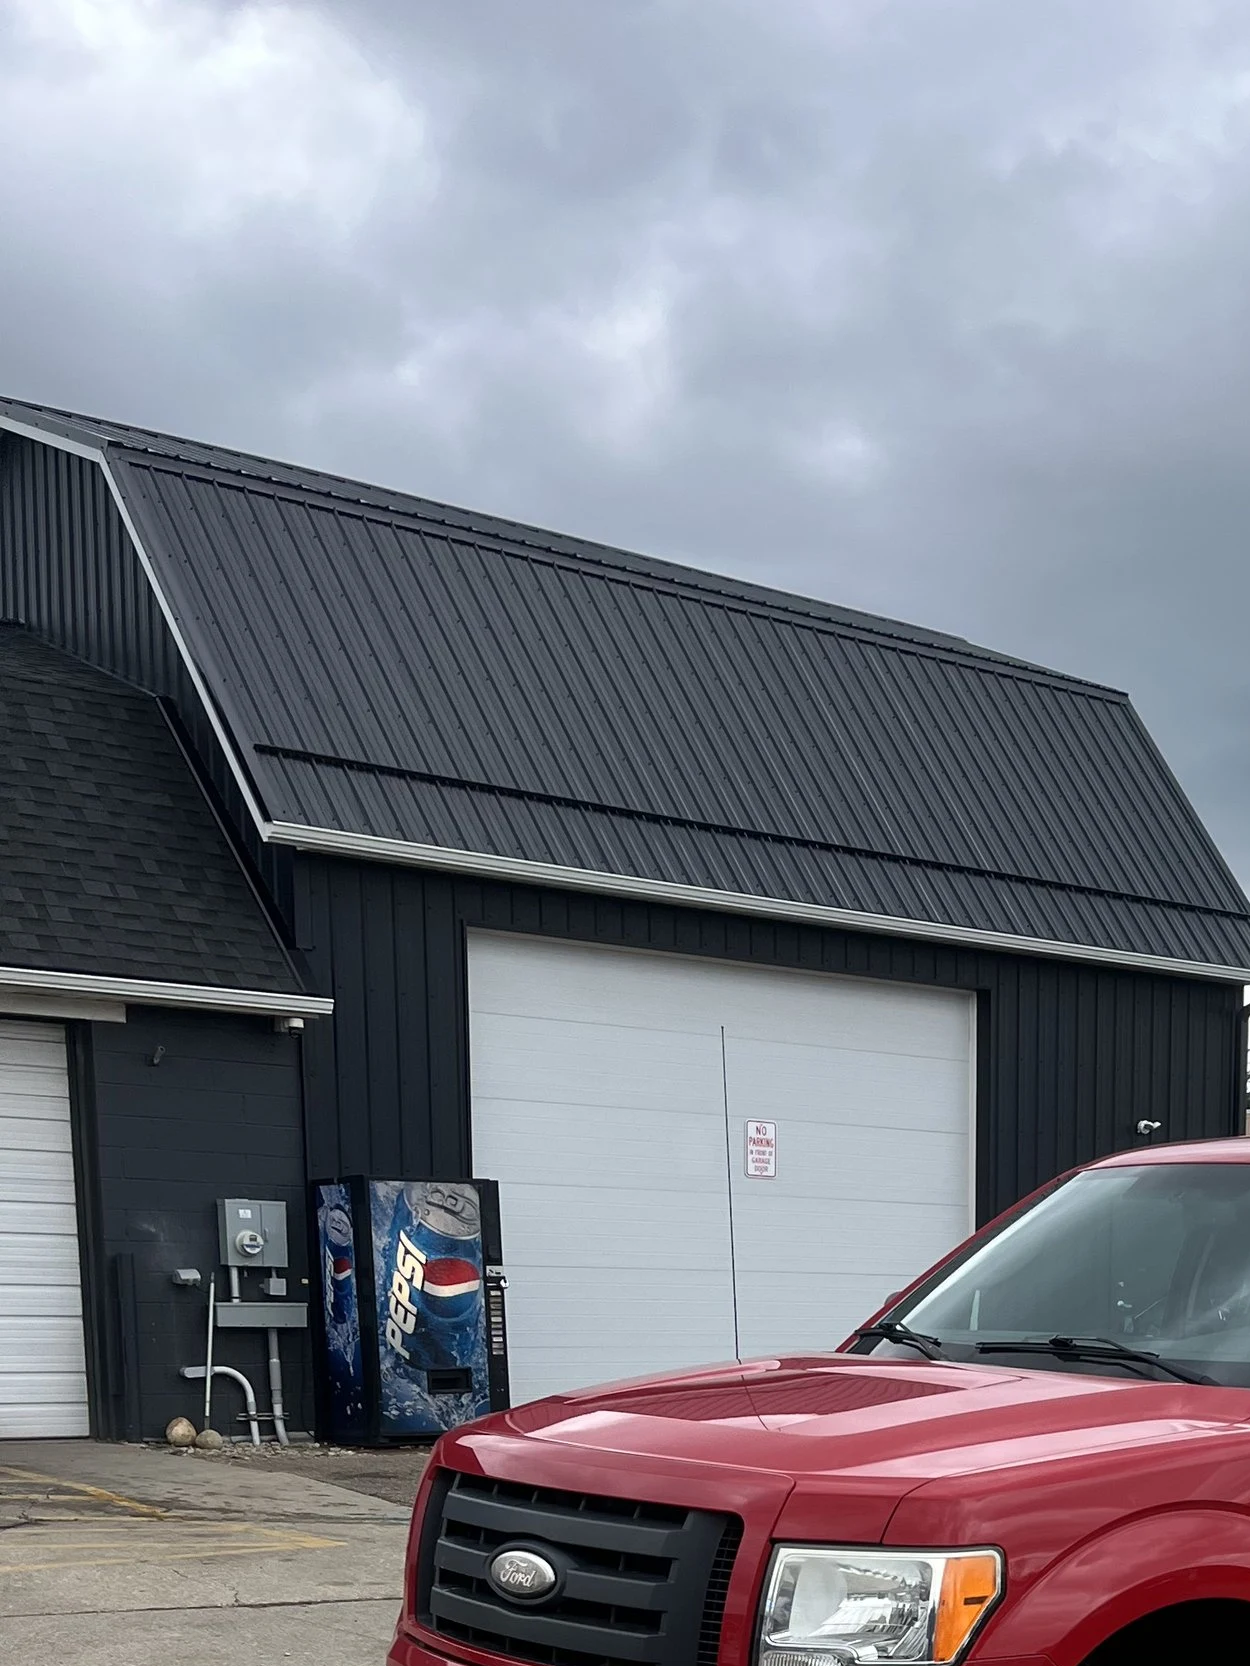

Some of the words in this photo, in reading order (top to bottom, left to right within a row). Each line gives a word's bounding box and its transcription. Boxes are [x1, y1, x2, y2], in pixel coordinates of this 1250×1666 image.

[749, 1136, 774, 1148] PARKING
[756, 1126, 767, 1136] NO
[325, 1245, 335, 1318] PEPSI
[386, 1229, 428, 1360] PEPSI
[500, 1559, 536, 1587] Ford
